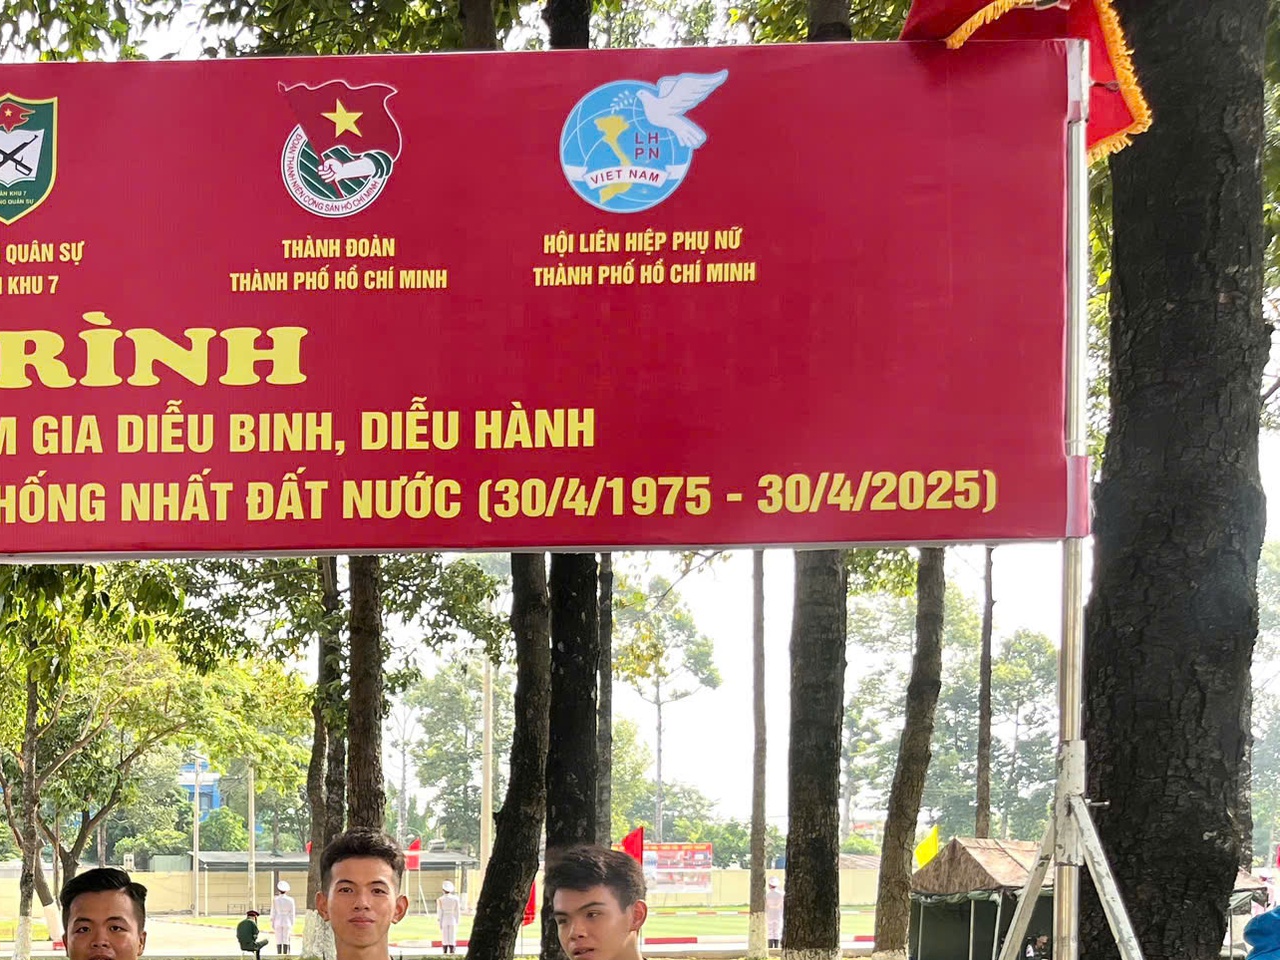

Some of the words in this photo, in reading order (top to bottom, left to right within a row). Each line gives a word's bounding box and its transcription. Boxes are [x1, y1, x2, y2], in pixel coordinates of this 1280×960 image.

[589, 169, 623, 185] VIET
[628, 169, 661, 183] NAM
[5, 239, 54, 265] QUÂN
[59, 240, 85, 266] SỰ
[281, 235, 341, 259] THÀNH
[345, 234, 395, 258] ĐOÀN
[543, 230, 574, 257] HỘI
[579, 229, 620, 253] LIÊN
[625, 228, 667, 255] HIỆP
[672, 230, 709, 254] PHỤ
[714, 226, 743, 250] NỮ
[7, 275, 43, 295] KHU
[47, 275, 59, 294] 7
[229, 268, 288, 292] THÀNH
[293, 265, 329, 291] PHỐ
[334, 265, 359, 290] HỒ
[364, 266, 394, 290] CHÍ
[399, 269, 448, 289] MINH
[532, 262, 593, 287] THÀNH
[598, 258, 635, 285] PHỐ
[640, 258, 665, 284] HỒ
[670, 259, 701, 284] CHÍ
[706, 262, 756, 283] MINH
[32, 414, 104, 455] GIA
[117, 399, 214, 453] DIỄU
[229, 412, 345, 456] BINH,
[361, 396, 459, 450] DIỄU
[475, 401, 595, 450] HÀNH
[121, 467, 234, 522] NHẤT
[245, 466, 329, 521] ĐẤT
[342, 471, 461, 519] NƯỚC
[478, 476, 711, 523] (30/4/1975
[757, 469, 997, 514] 30/4/2025)
